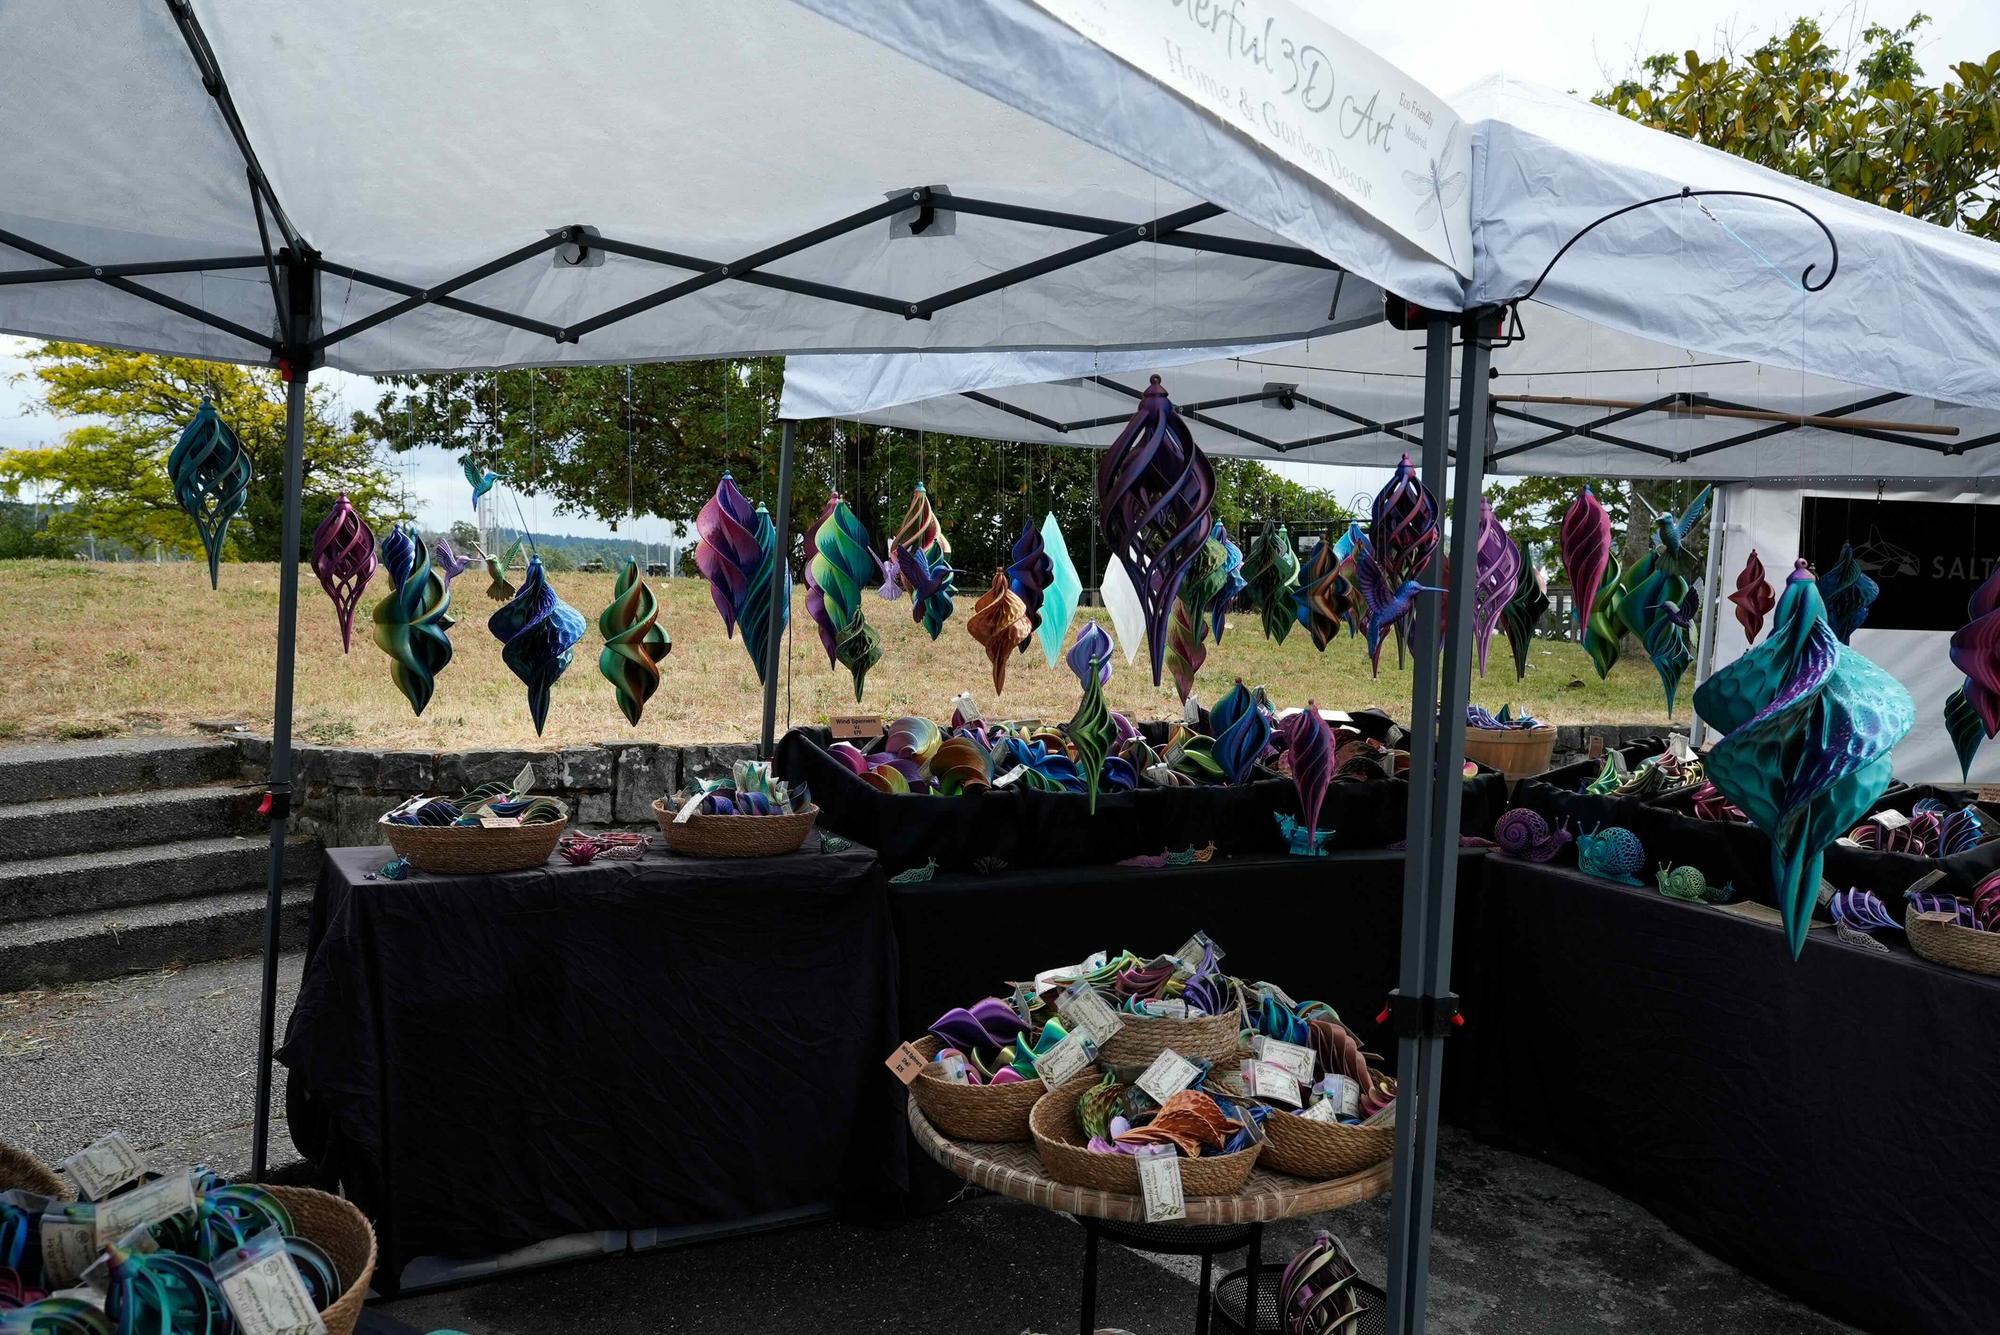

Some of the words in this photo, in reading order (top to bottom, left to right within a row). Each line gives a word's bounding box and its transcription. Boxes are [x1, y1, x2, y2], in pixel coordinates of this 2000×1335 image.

[1164, 36, 1232, 109] Home
[1239, 87, 1260, 126] &
[1262, 101, 1329, 171] Garden
[1327, 147, 1374, 200] Decor
[1281, 38, 1335, 113] 3D
[1339, 89, 1395, 153] Art
[1399, 91, 1410, 110] Eco
[1410, 100, 1433, 129] Friendly
